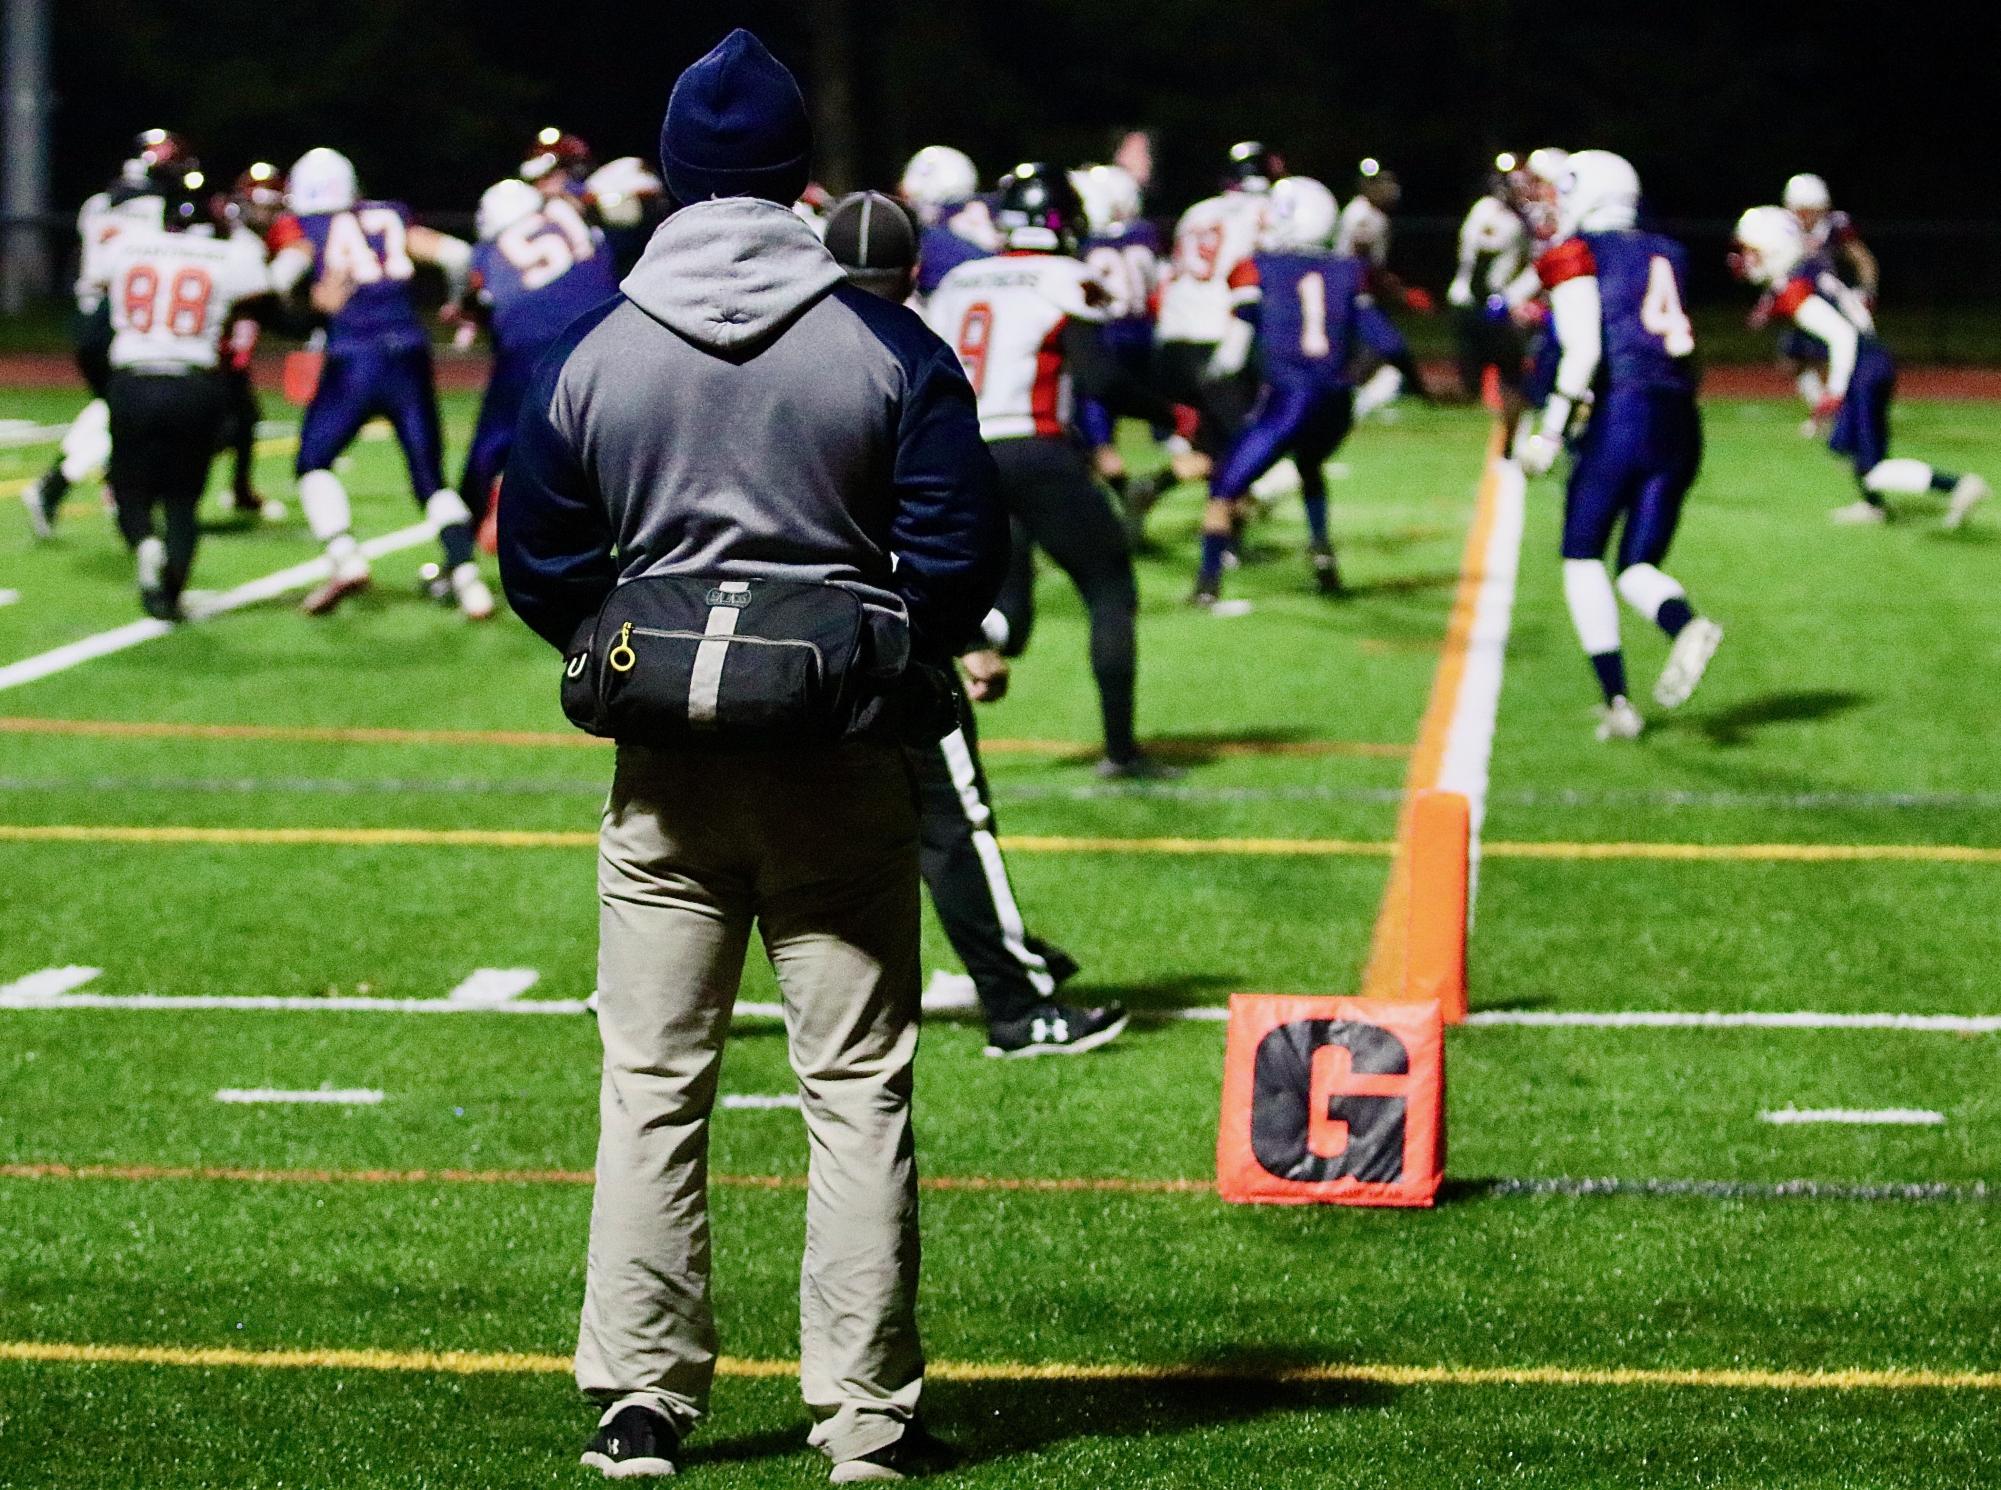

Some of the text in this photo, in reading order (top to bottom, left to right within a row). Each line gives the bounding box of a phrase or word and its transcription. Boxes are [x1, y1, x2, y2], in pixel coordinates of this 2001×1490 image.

[325, 208, 416, 283] 47
[500, 198, 597, 291] 51
[124, 264, 213, 337] 88
[1299, 271, 1331, 359] 1
[1639, 254, 1695, 358] 4
[957, 302, 994, 398] 9
[1251, 1018, 1410, 1184] G
